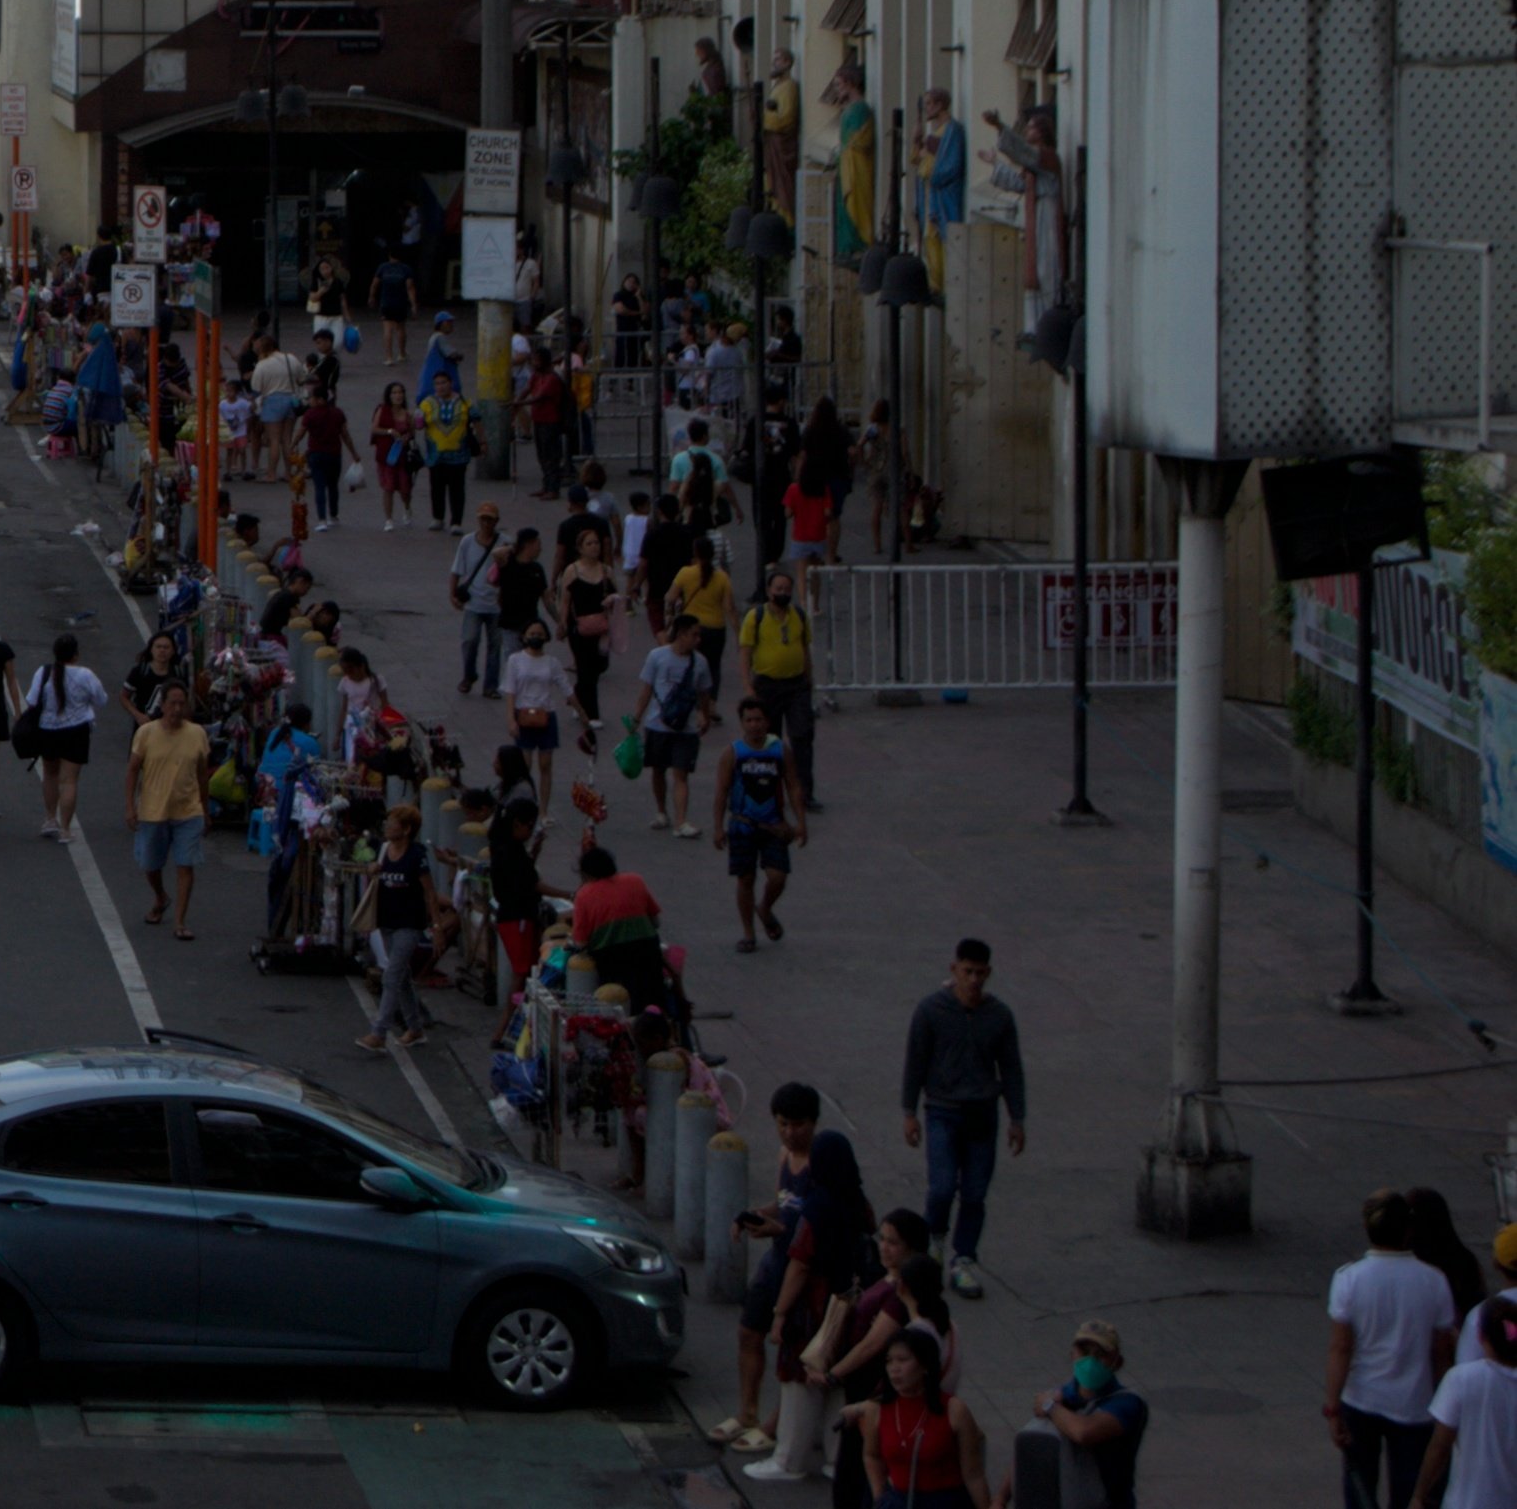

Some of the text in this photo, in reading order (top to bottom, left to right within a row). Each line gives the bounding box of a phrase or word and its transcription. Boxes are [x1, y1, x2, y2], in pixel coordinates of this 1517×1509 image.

[469, 135, 518, 151] CHURCH
[474, 151, 512, 165] ZONE
[473, 178, 485, 187] OF
